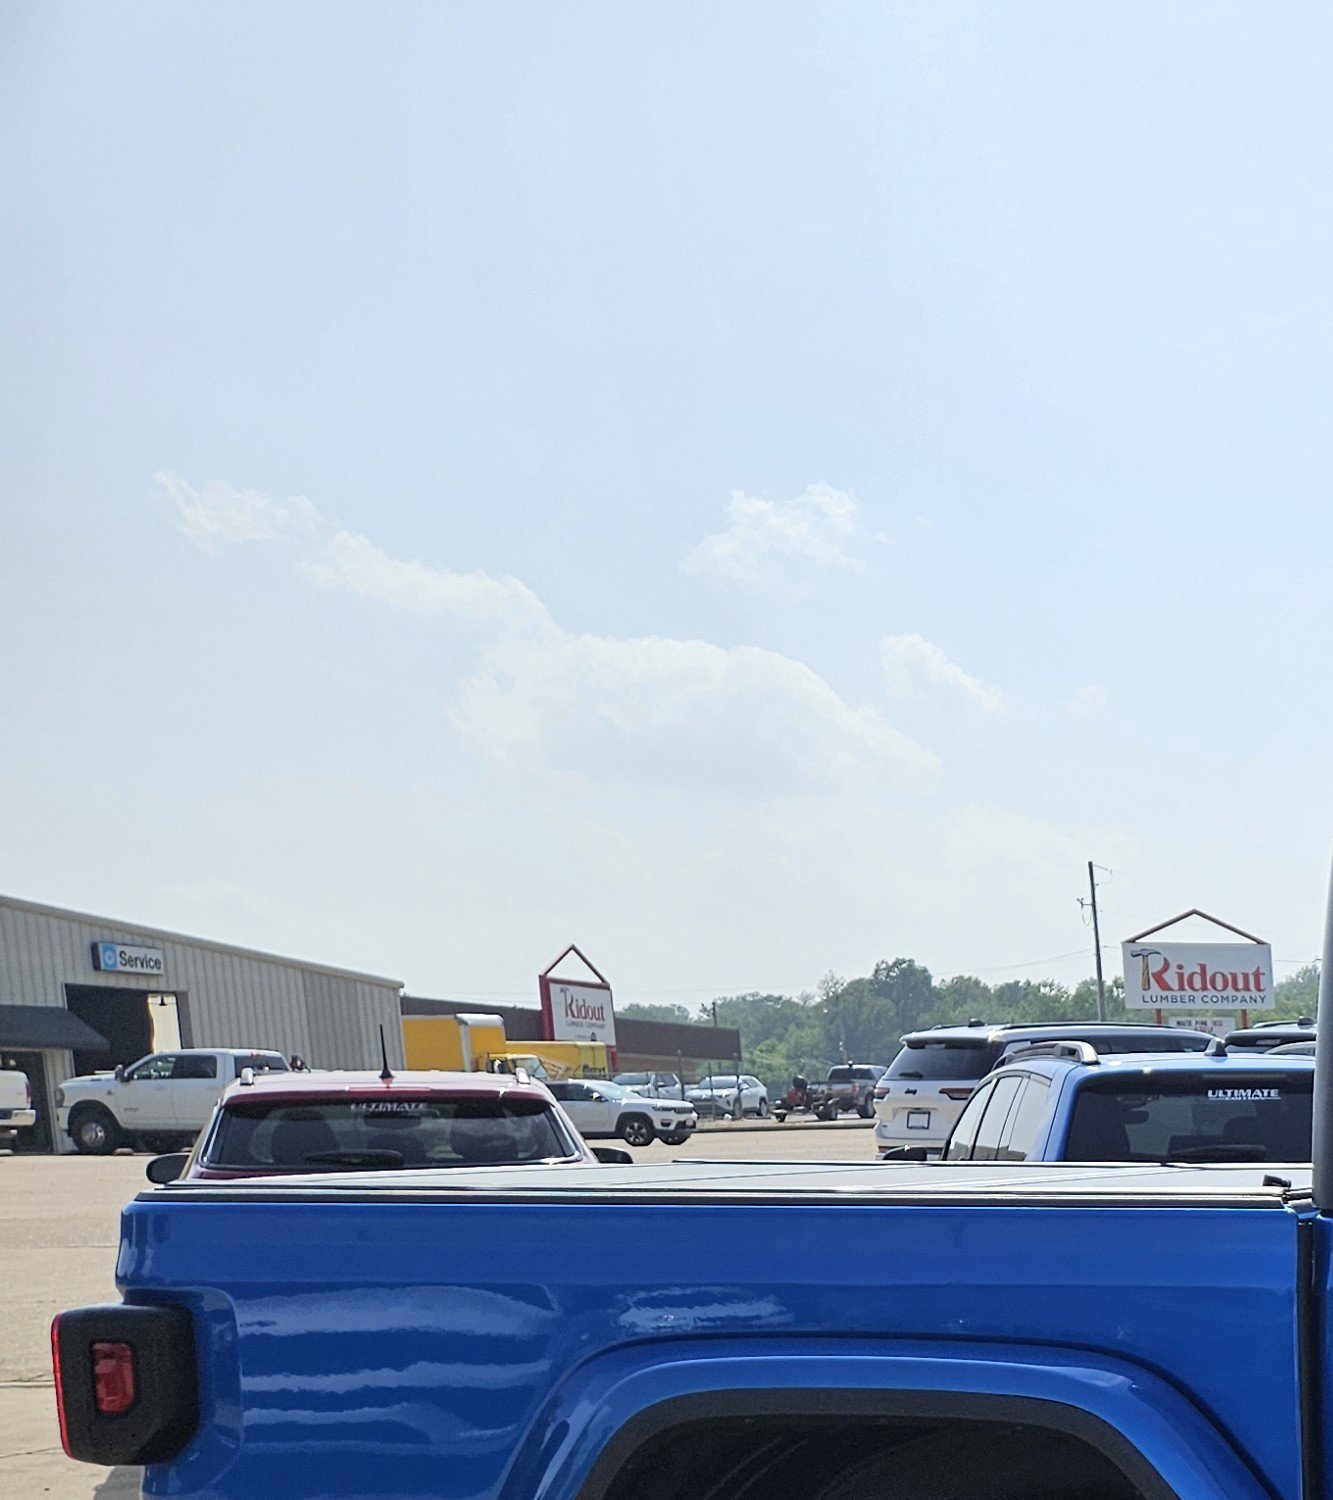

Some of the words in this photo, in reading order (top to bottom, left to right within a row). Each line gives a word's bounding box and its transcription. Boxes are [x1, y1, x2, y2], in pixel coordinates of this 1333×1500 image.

[119, 950, 162, 970] Service
[1130, 949, 1266, 993] Ridout
[561, 987, 606, 1022] Ridout
[1142, 994, 1196, 1004] LUMBER
[1201, 994, 1267, 1005] COMPANY
[1207, 1089, 1279, 1098] ULTIMATE
